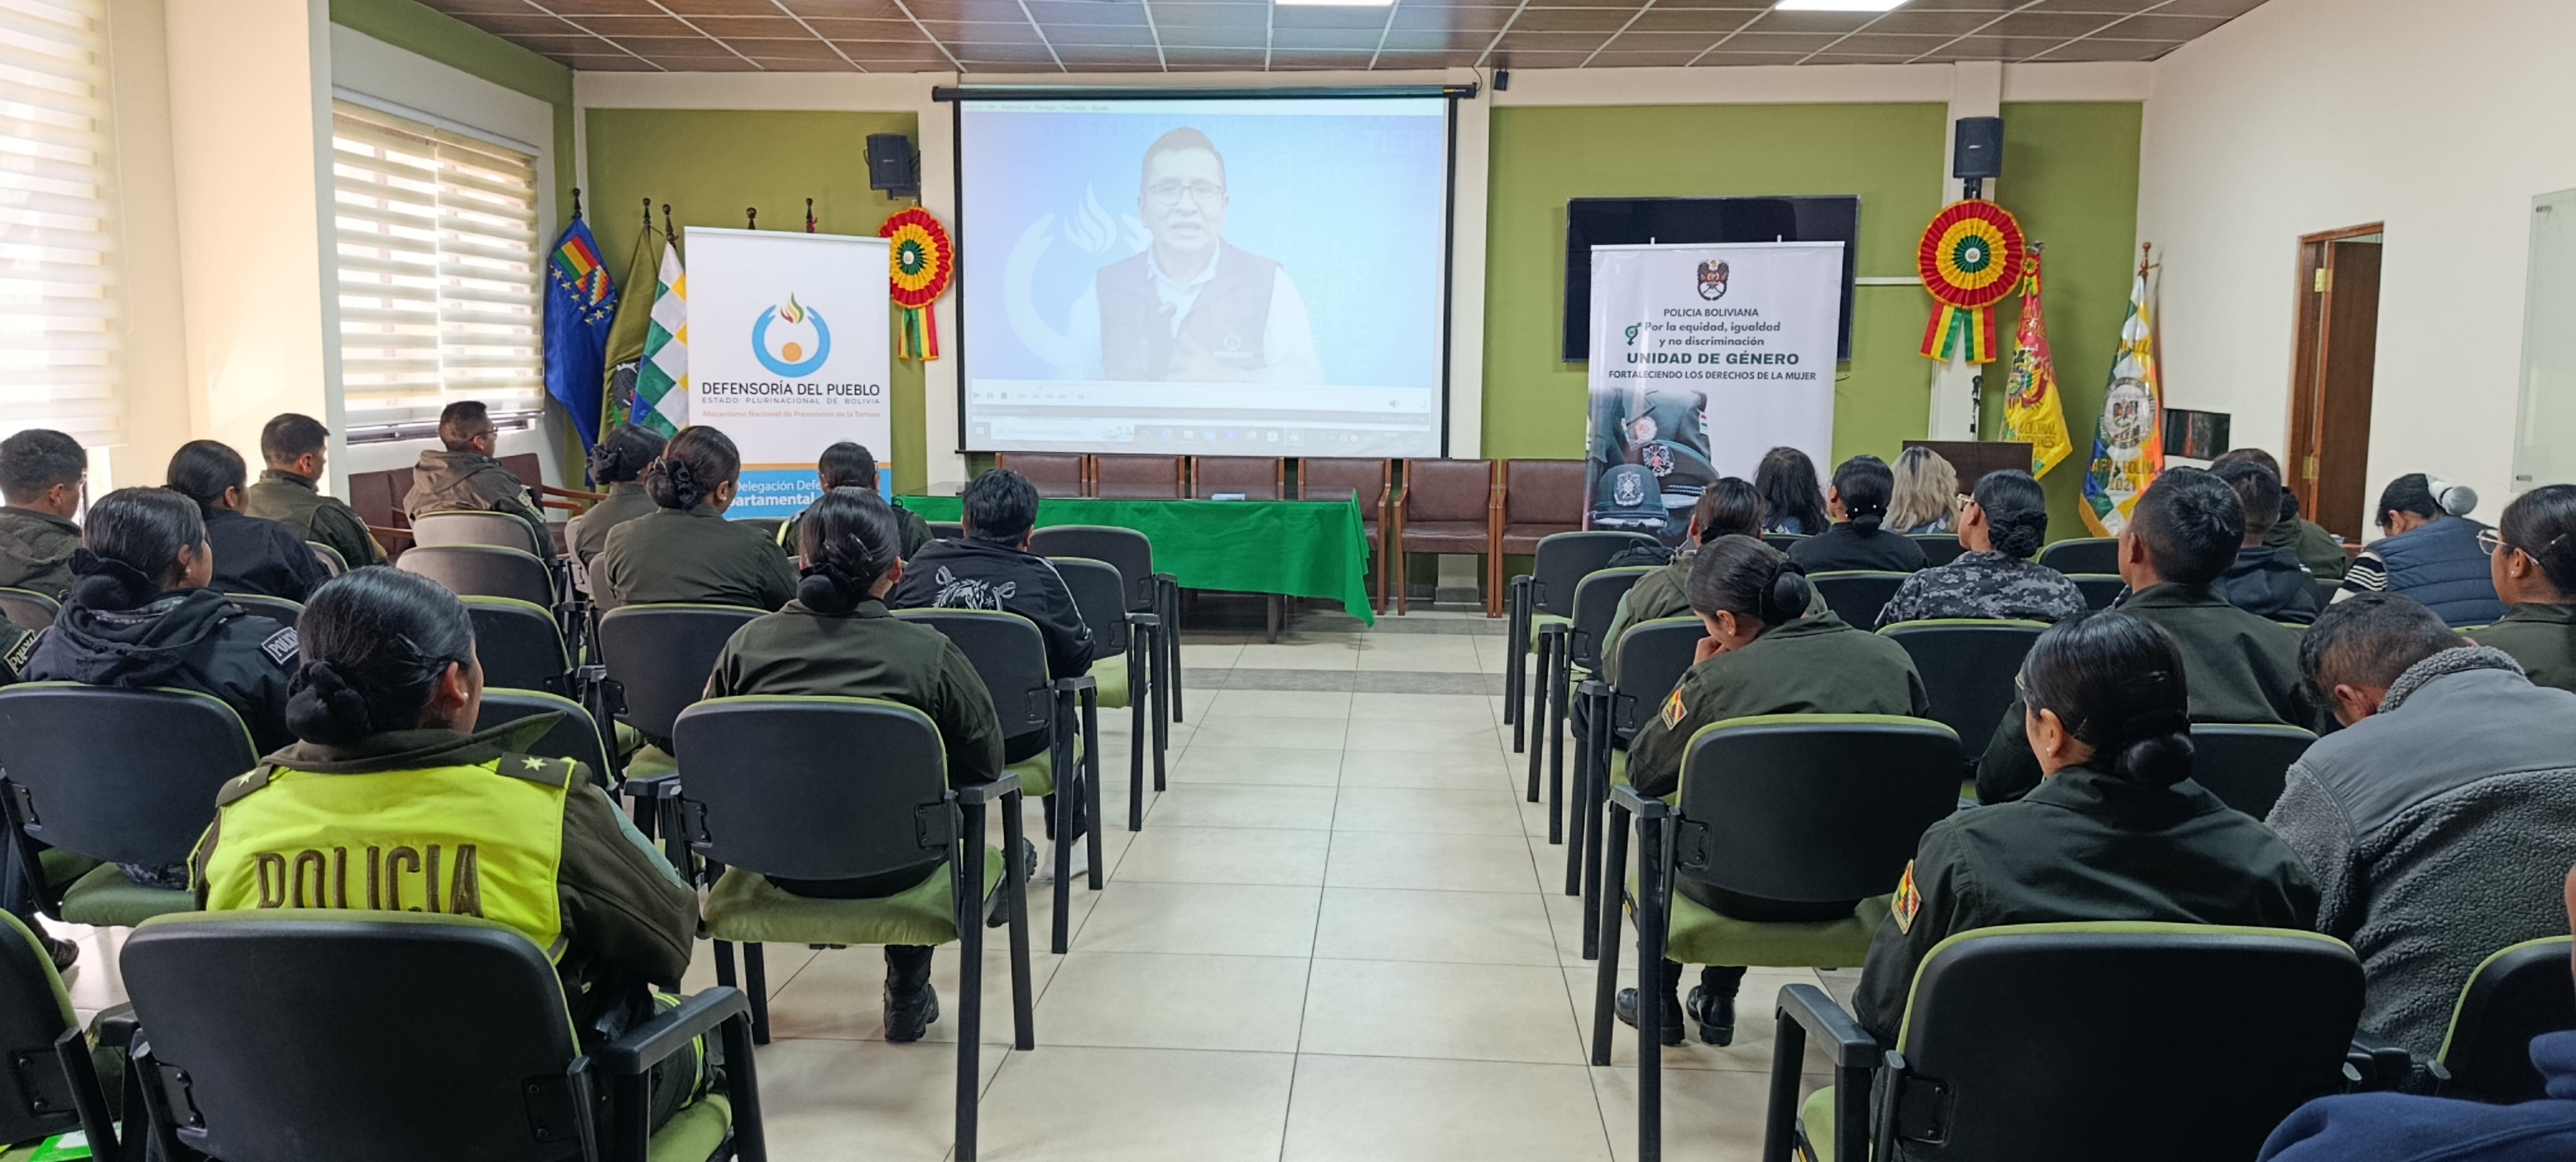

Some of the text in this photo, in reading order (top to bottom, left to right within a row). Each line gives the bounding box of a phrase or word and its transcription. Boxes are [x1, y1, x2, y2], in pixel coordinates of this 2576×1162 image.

[1664, 309, 1759, 317] POLICIA BOLIVIANA
[1645, 321, 1780, 334] Por la equidad, igualdad
[1659, 338, 1666, 348] y
[1685, 336, 1764, 345] discriminación
[1627, 350, 1799, 365] UNIDAD DE GÉNERO
[1609, 371, 1683, 379] FORTALECIENDO
[1685, 371, 1703, 379] LOS
[1785, 372, 1816, 380] MUJER
[702, 380, 880, 396] DEFENSORÍA DEL PUEBLO
[796, 480, 821, 490] Defe
[255, 843, 485, 918] POLICIA
